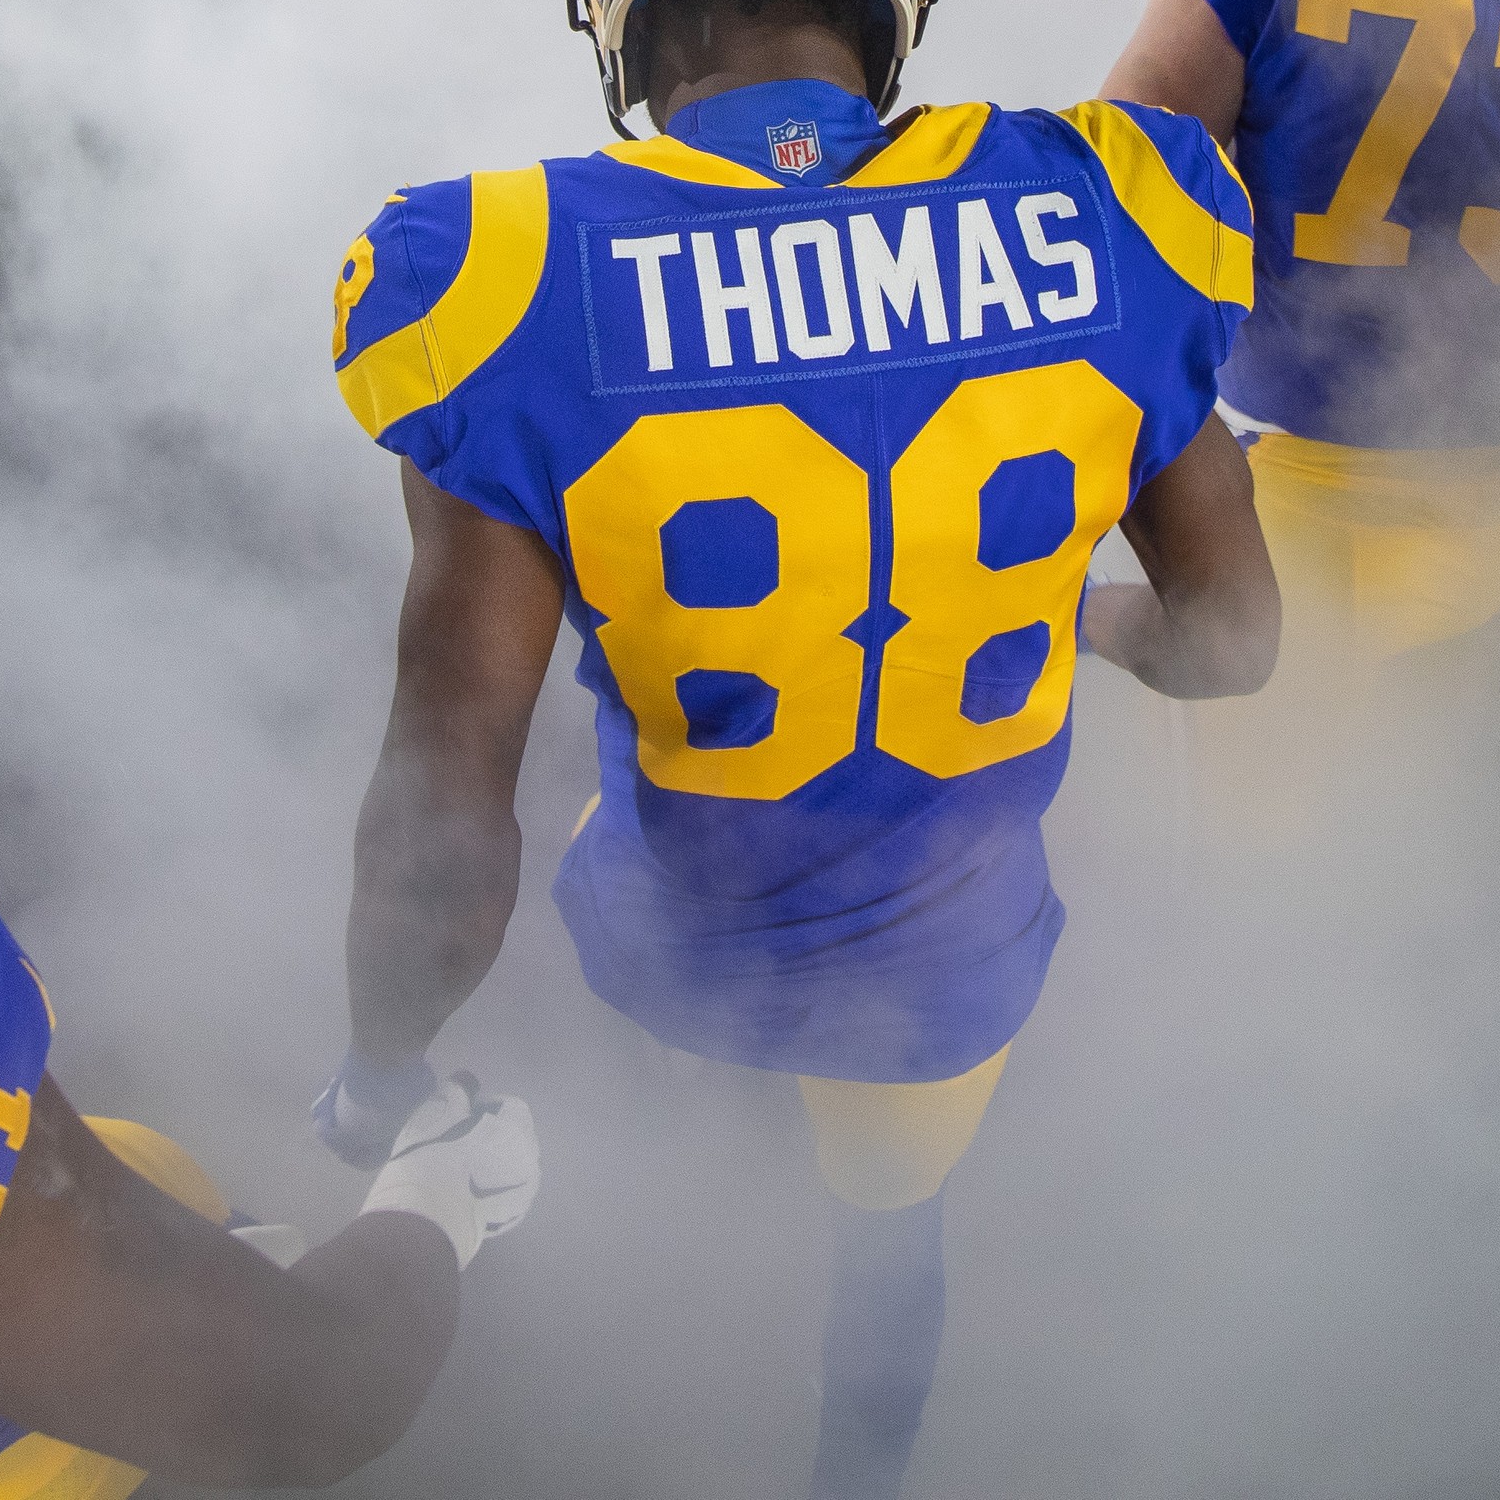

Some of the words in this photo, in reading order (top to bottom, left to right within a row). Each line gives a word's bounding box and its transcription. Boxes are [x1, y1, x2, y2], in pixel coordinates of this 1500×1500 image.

[775, 139, 816, 169] NFL
[611, 190, 1099, 372] THOMAS
[563, 358, 1145, 801] 88
